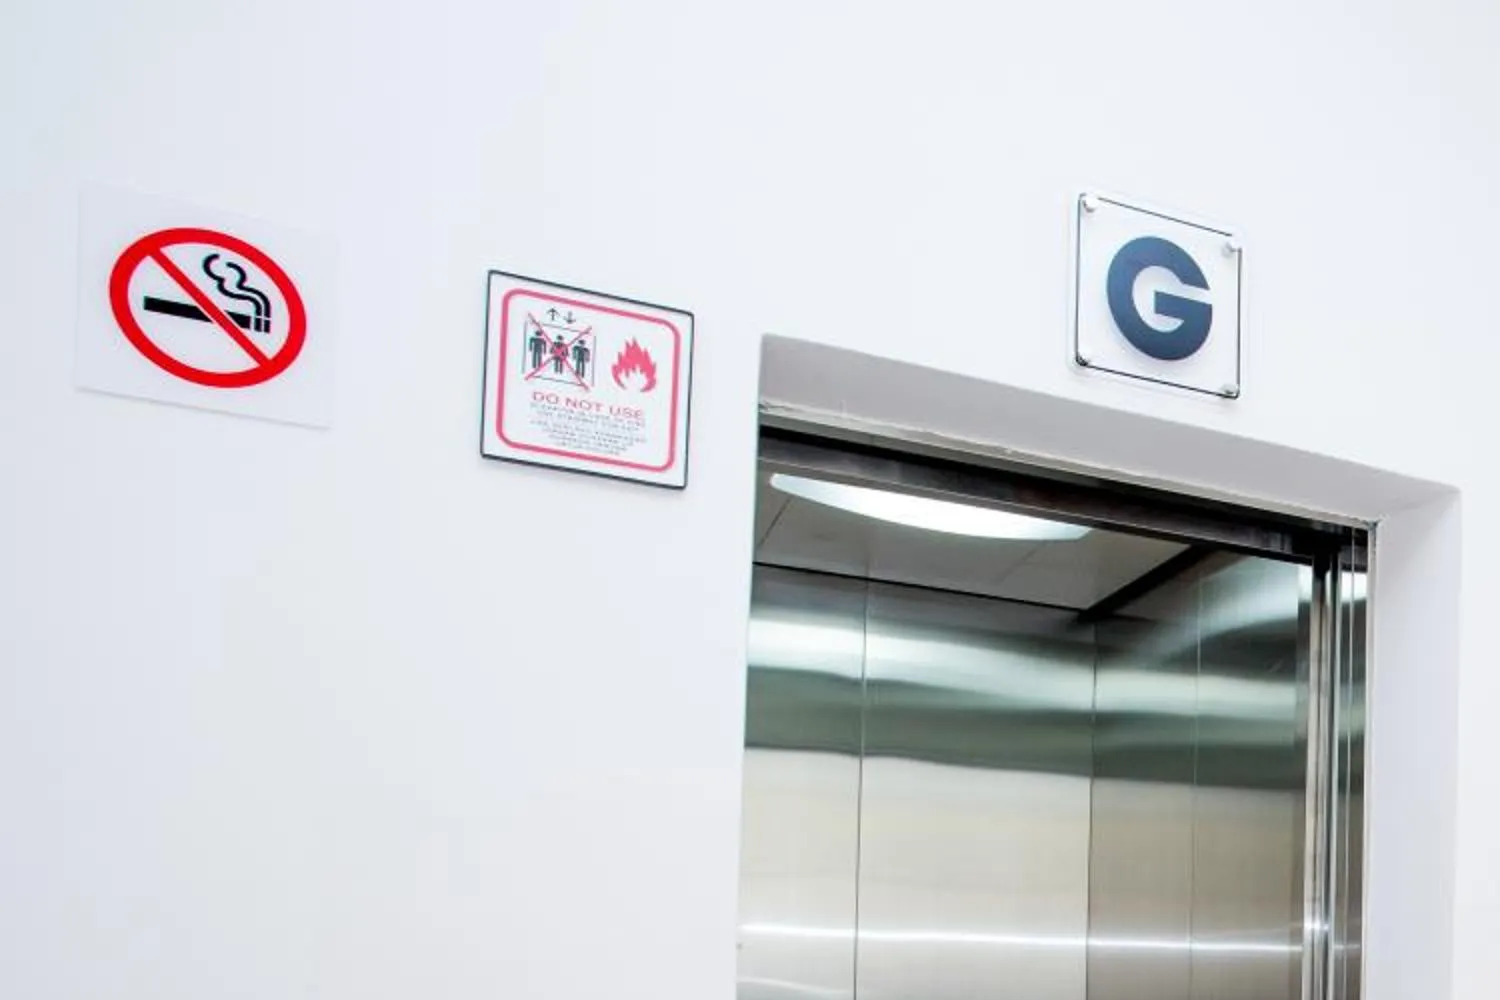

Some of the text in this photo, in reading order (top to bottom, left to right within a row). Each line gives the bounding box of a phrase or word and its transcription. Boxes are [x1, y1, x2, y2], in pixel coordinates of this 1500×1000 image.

[1106, 235, 1213, 361] G
[533, 391, 559, 405] DO
[565, 397, 604, 412] NOT
[609, 405, 643, 419] USE
